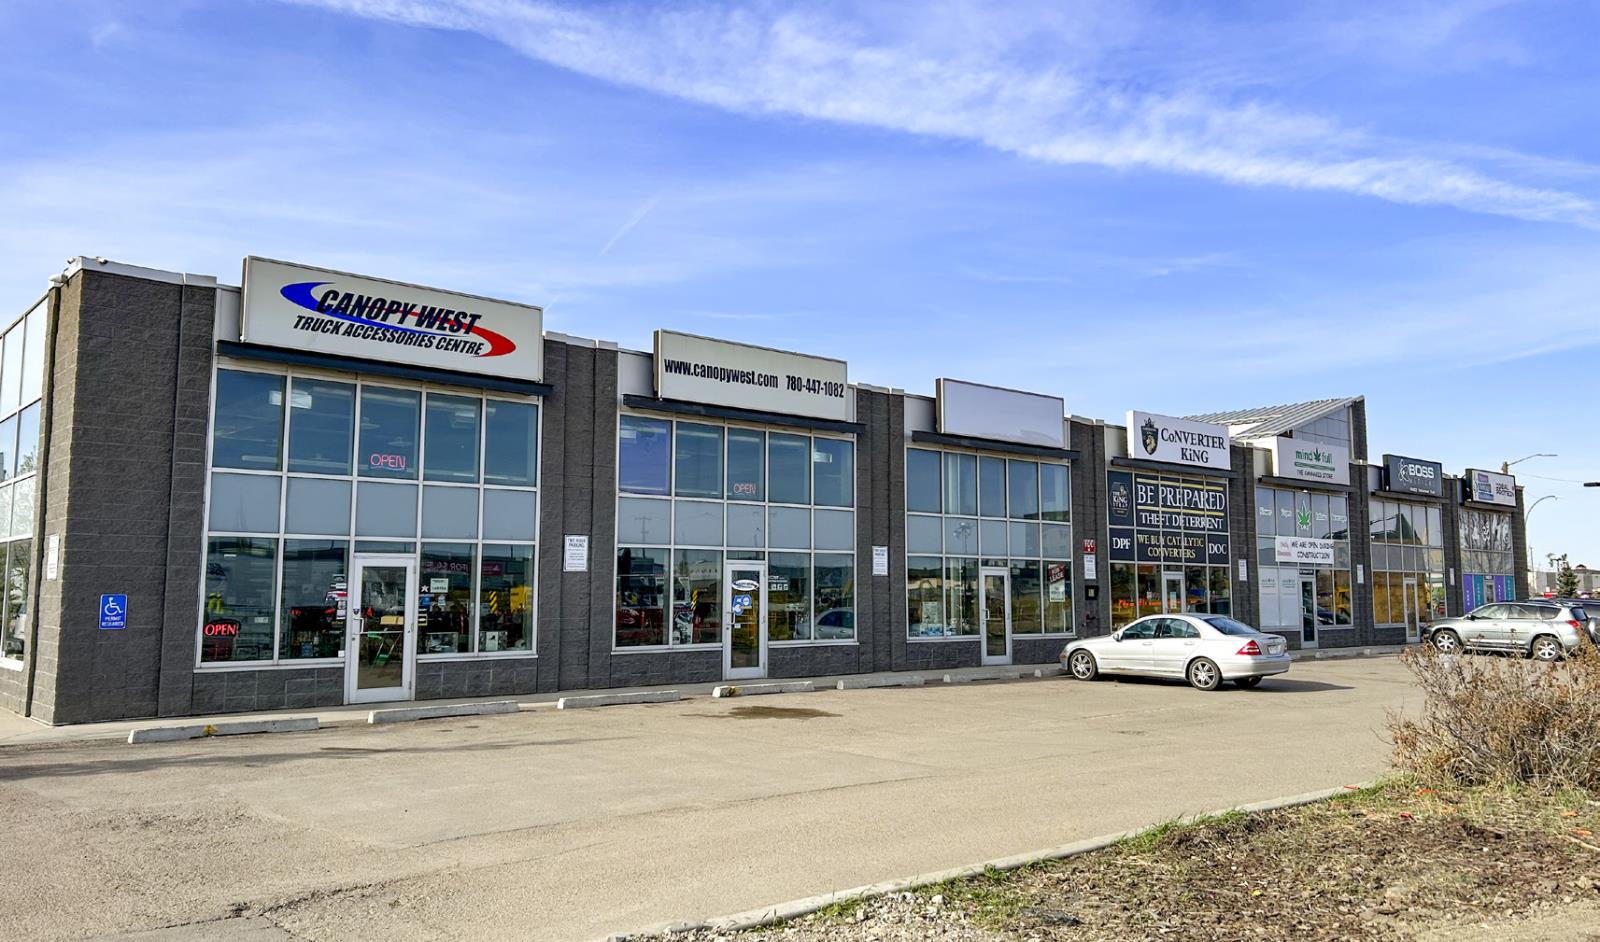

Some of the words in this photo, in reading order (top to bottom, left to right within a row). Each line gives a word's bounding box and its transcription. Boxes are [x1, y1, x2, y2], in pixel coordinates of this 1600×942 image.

[316, 289, 416, 324] CANOPY
[416, 306, 482, 335] WEST
[293, 315, 342, 335] TRUCK
[343, 322, 435, 349] ACCESSORIES
[435, 336, 484, 355] CENTRE
[664, 358, 779, 389] www.canopywest.com
[785, 375, 844, 398] 780-447-1082
[370, 453, 406, 468] OPEN
[1408, 464, 1434, 478] BOSS
[733, 483, 756, 495] OPEN
[1136, 484, 1155, 504] BE
[1159, 486, 1226, 510] PREPARED
[1140, 512, 1170, 526] THEFT
[1172, 514, 1224, 529] DETERRENT
[1112, 537, 1131, 550] DPF
[1136, 534, 1150, 544] WE
[1150, 535, 1165, 546] BUY
[1166, 536, 1204, 548] CATLYTIC
[1208, 543, 1228, 555] DOC
[1296, 551, 1330, 560] CONSTRUCTION
[204, 623, 237, 636] OPEN
